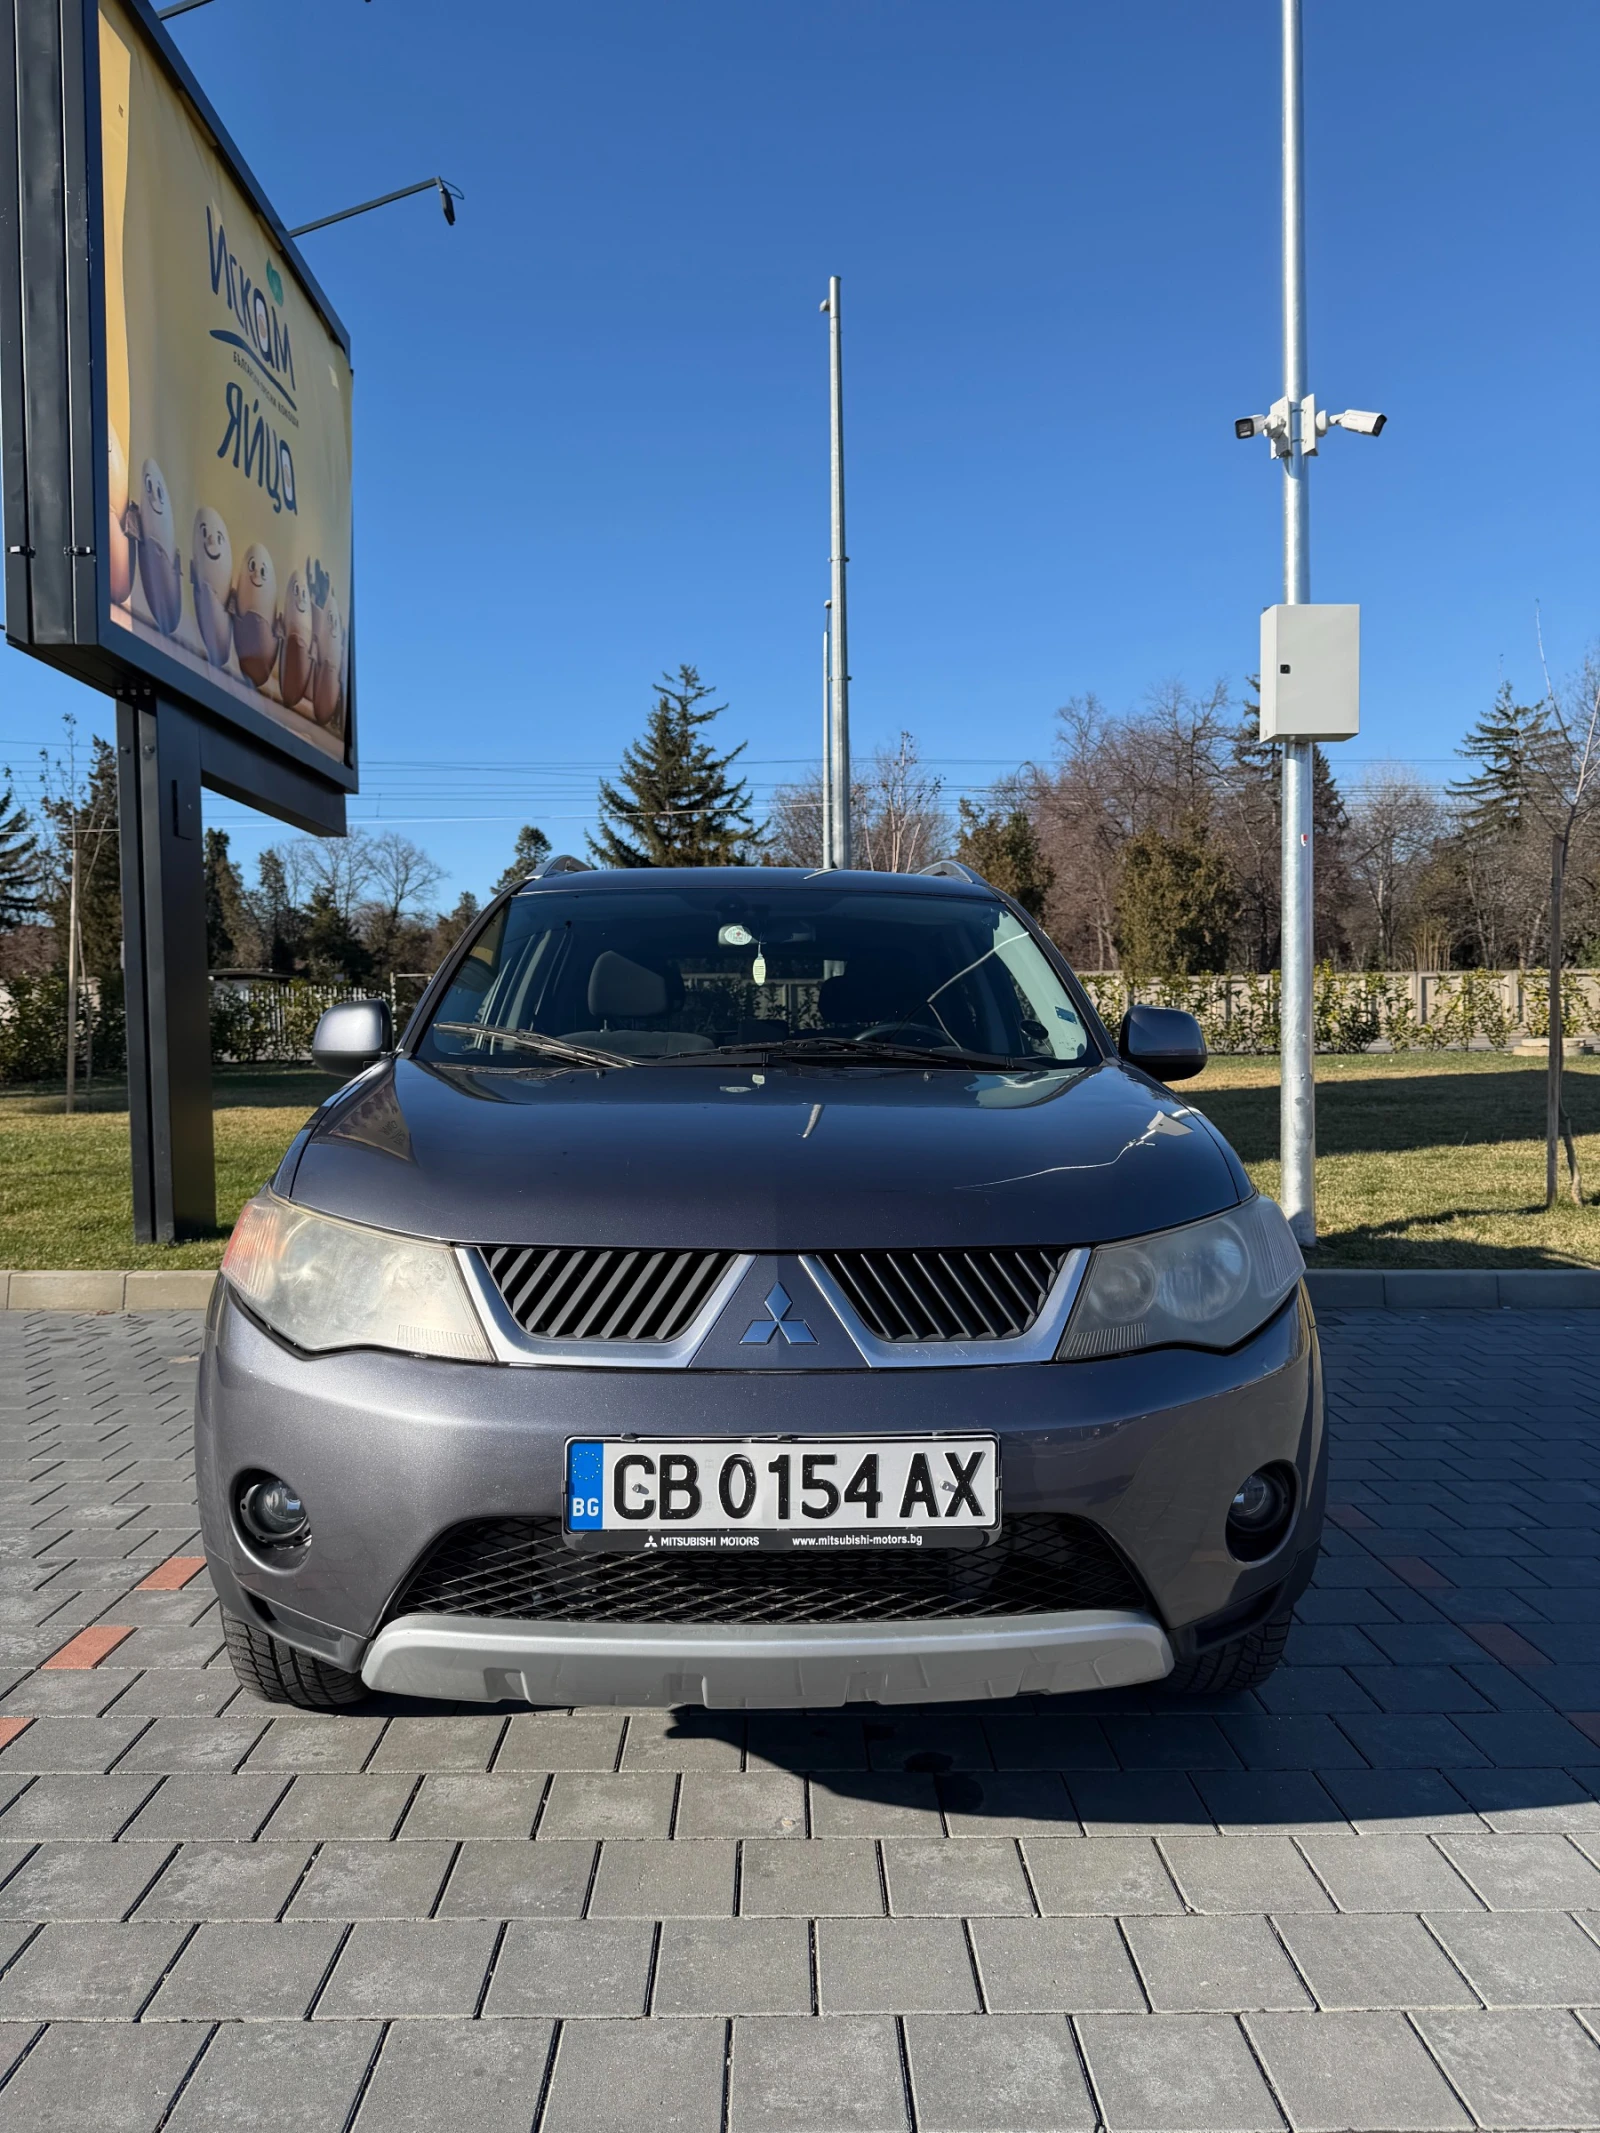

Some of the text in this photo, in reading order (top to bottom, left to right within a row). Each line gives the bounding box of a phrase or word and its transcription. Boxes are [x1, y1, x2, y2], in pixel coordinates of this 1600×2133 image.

[206, 205, 296, 391] Искам
[613, 1452, 986, 1520] CB 0154 AX
[572, 1498, 600, 1517] BG
[660, 1536, 760, 1547] MITSUBISHI MOTORS
[792, 1534, 923, 1546] www.mitsubishi-motors.bg
